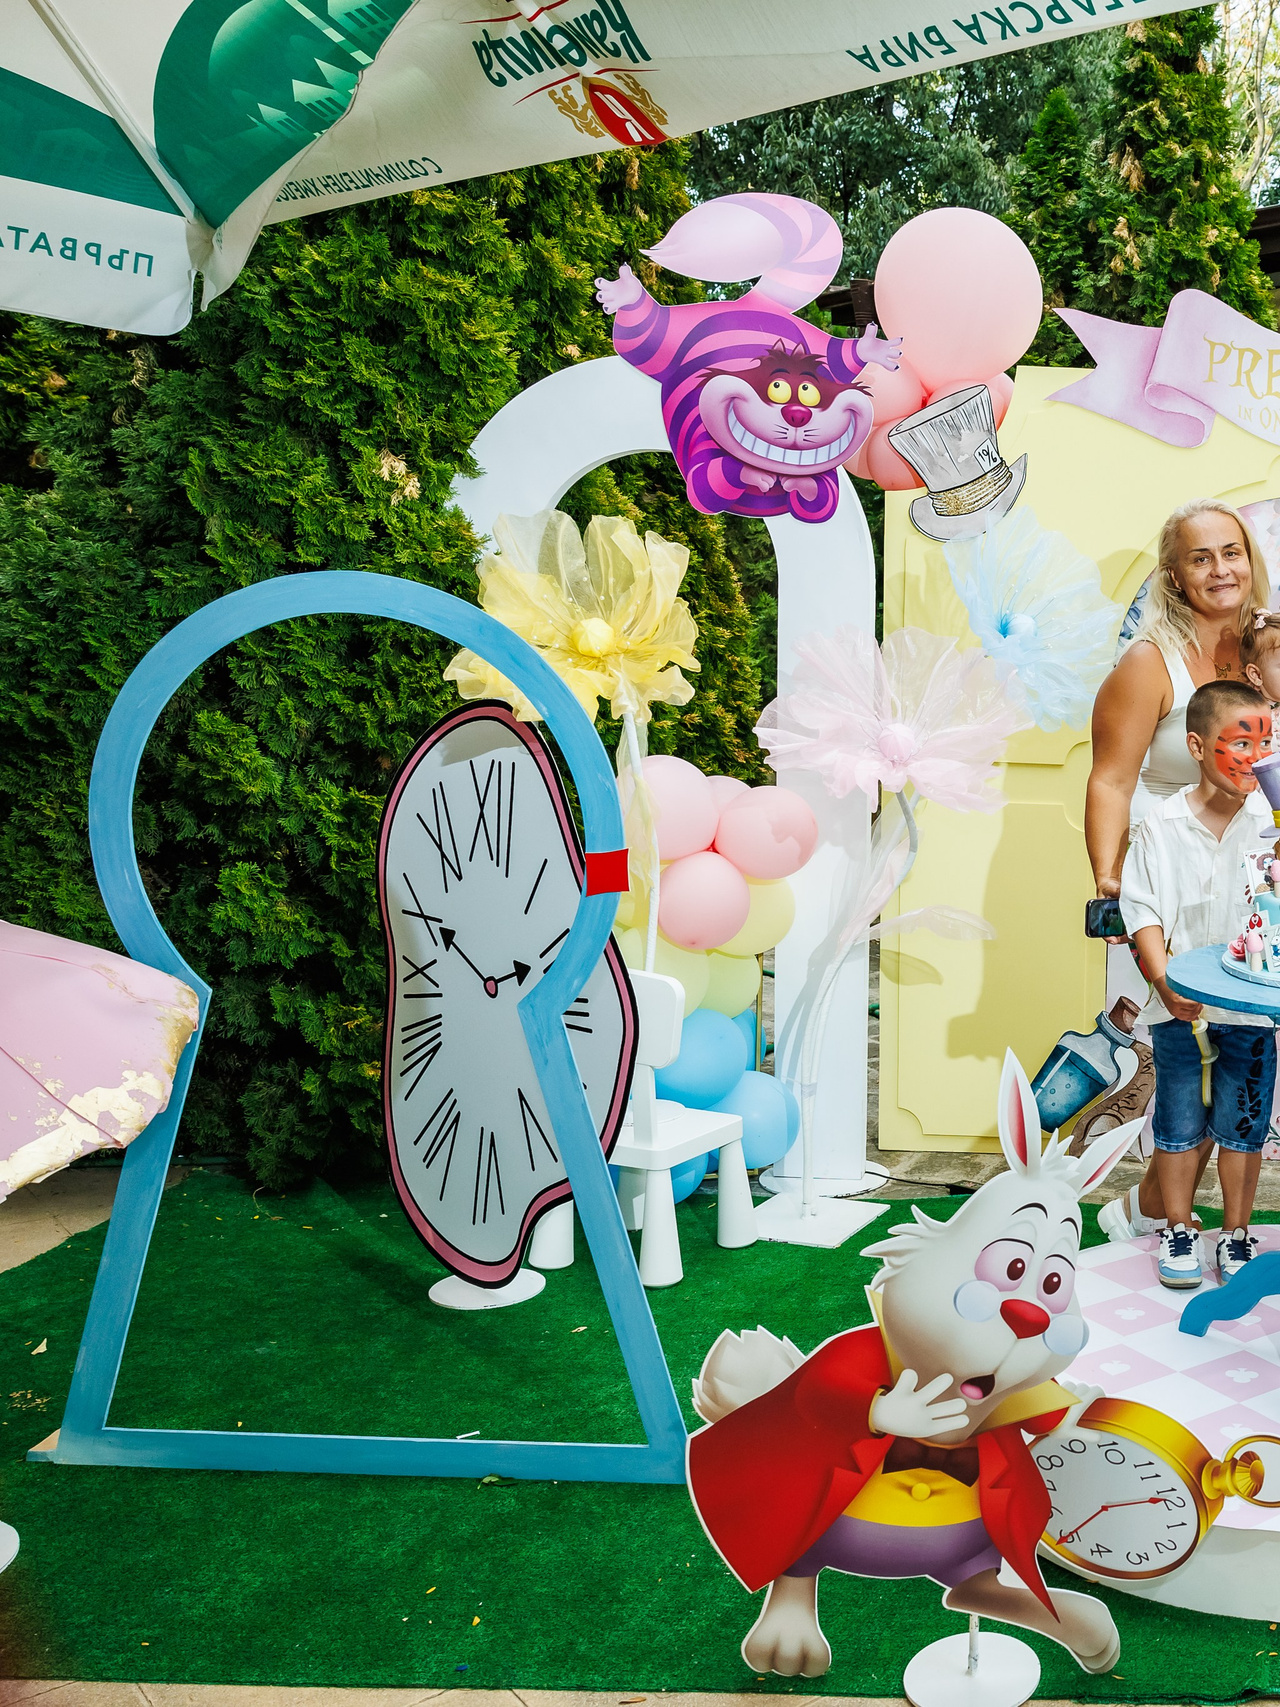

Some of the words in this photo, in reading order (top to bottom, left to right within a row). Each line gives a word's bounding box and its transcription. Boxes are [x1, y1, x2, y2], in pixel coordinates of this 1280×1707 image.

[845, 24, 958, 74] БИРА
[317, 158, 430, 194] ОТЛИЧИТЕЛЕН
[275, 176, 326, 203] ХМЕЛО
[1237, 404, 1253, 423] IN
[1036, 1453, 1064, 1471] 8
[1097, 1440, 1126, 1466] 10
[1133, 1459, 1162, 1482] 11
[1156, 1486, 1187, 1512] 12
[1090, 1542, 1114, 1559] 4
[1154, 1538, 1178, 1554] 2
[1125, 1551, 1150, 1566] 3
